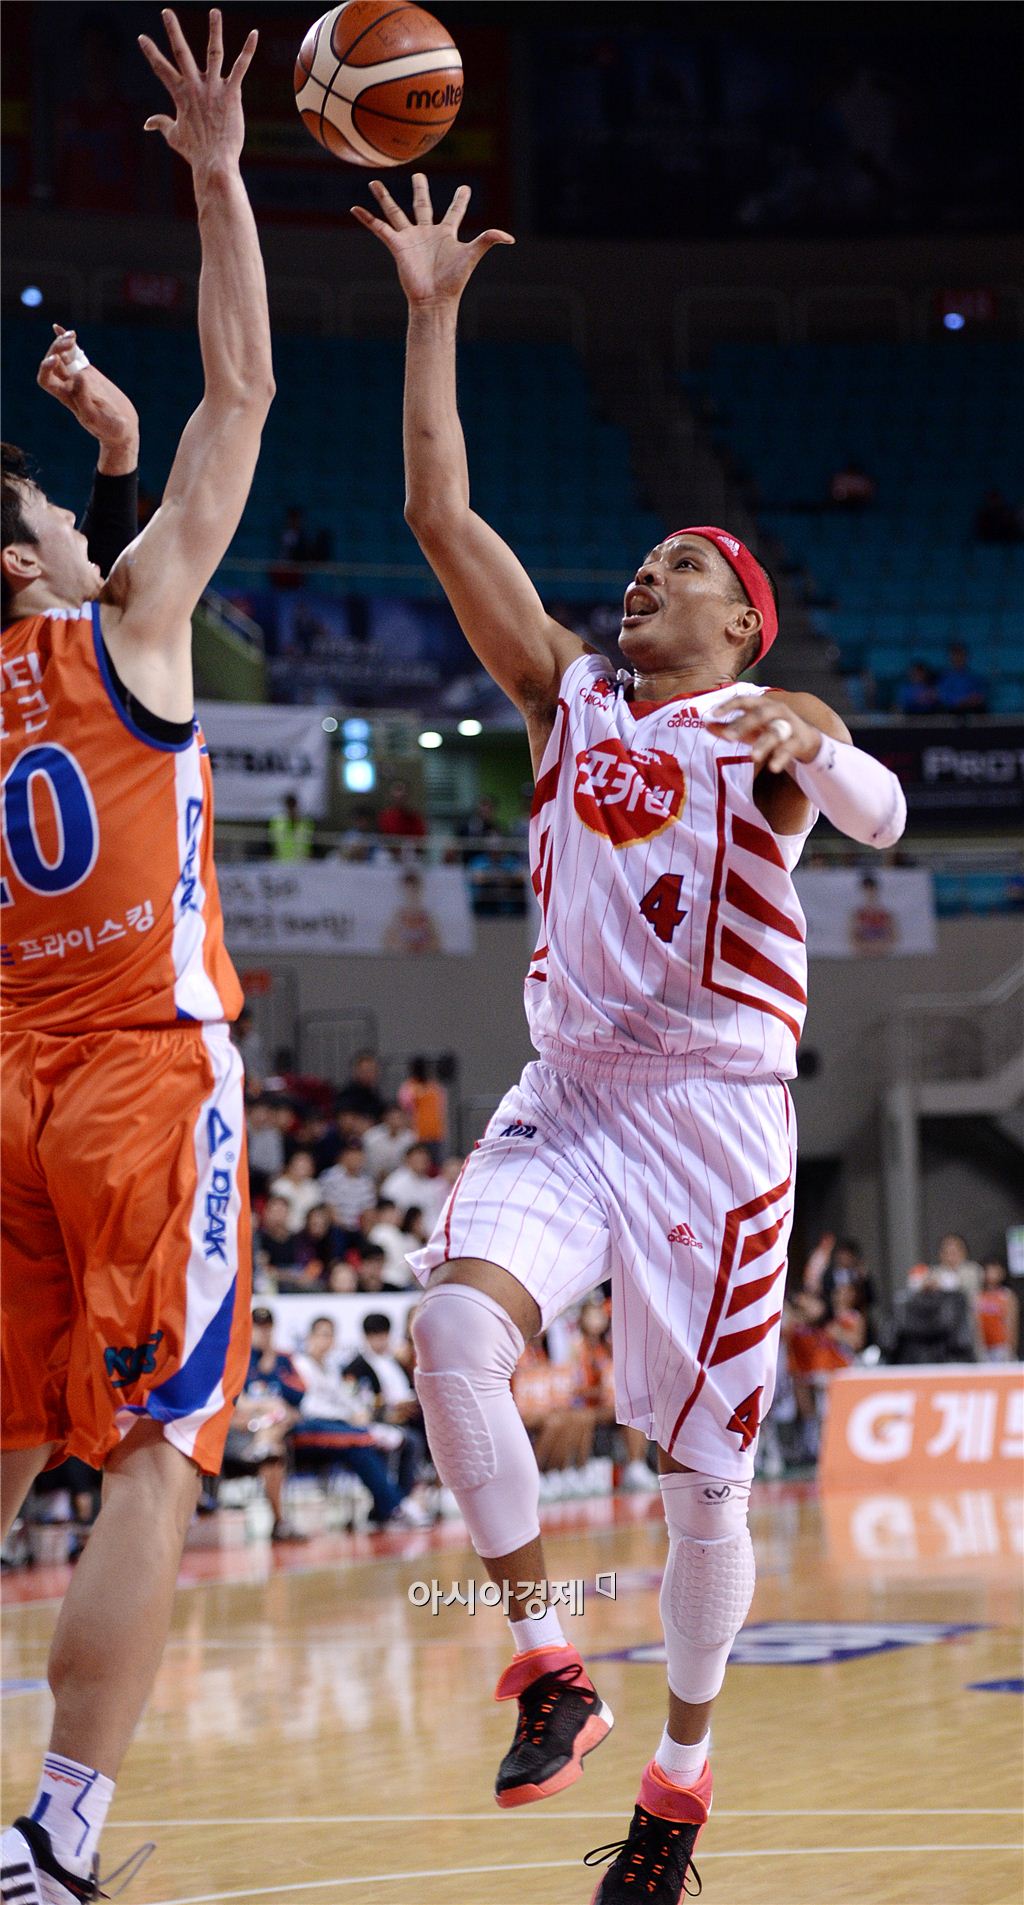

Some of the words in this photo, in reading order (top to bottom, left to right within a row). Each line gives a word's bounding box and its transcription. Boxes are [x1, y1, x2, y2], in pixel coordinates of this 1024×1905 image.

[406, 84, 464, 110] molte
[667, 718, 706, 729] adidas
[921, 745, 1024, 783] PRO
[0, 741, 99, 909] 0
[18, 900, 156, 961] 프라이스킹
[640, 873, 688, 943] 4
[204, 1167, 232, 1266] DEAK
[726, 1385, 764, 1452] 4
[846, 1387, 917, 1465] G
